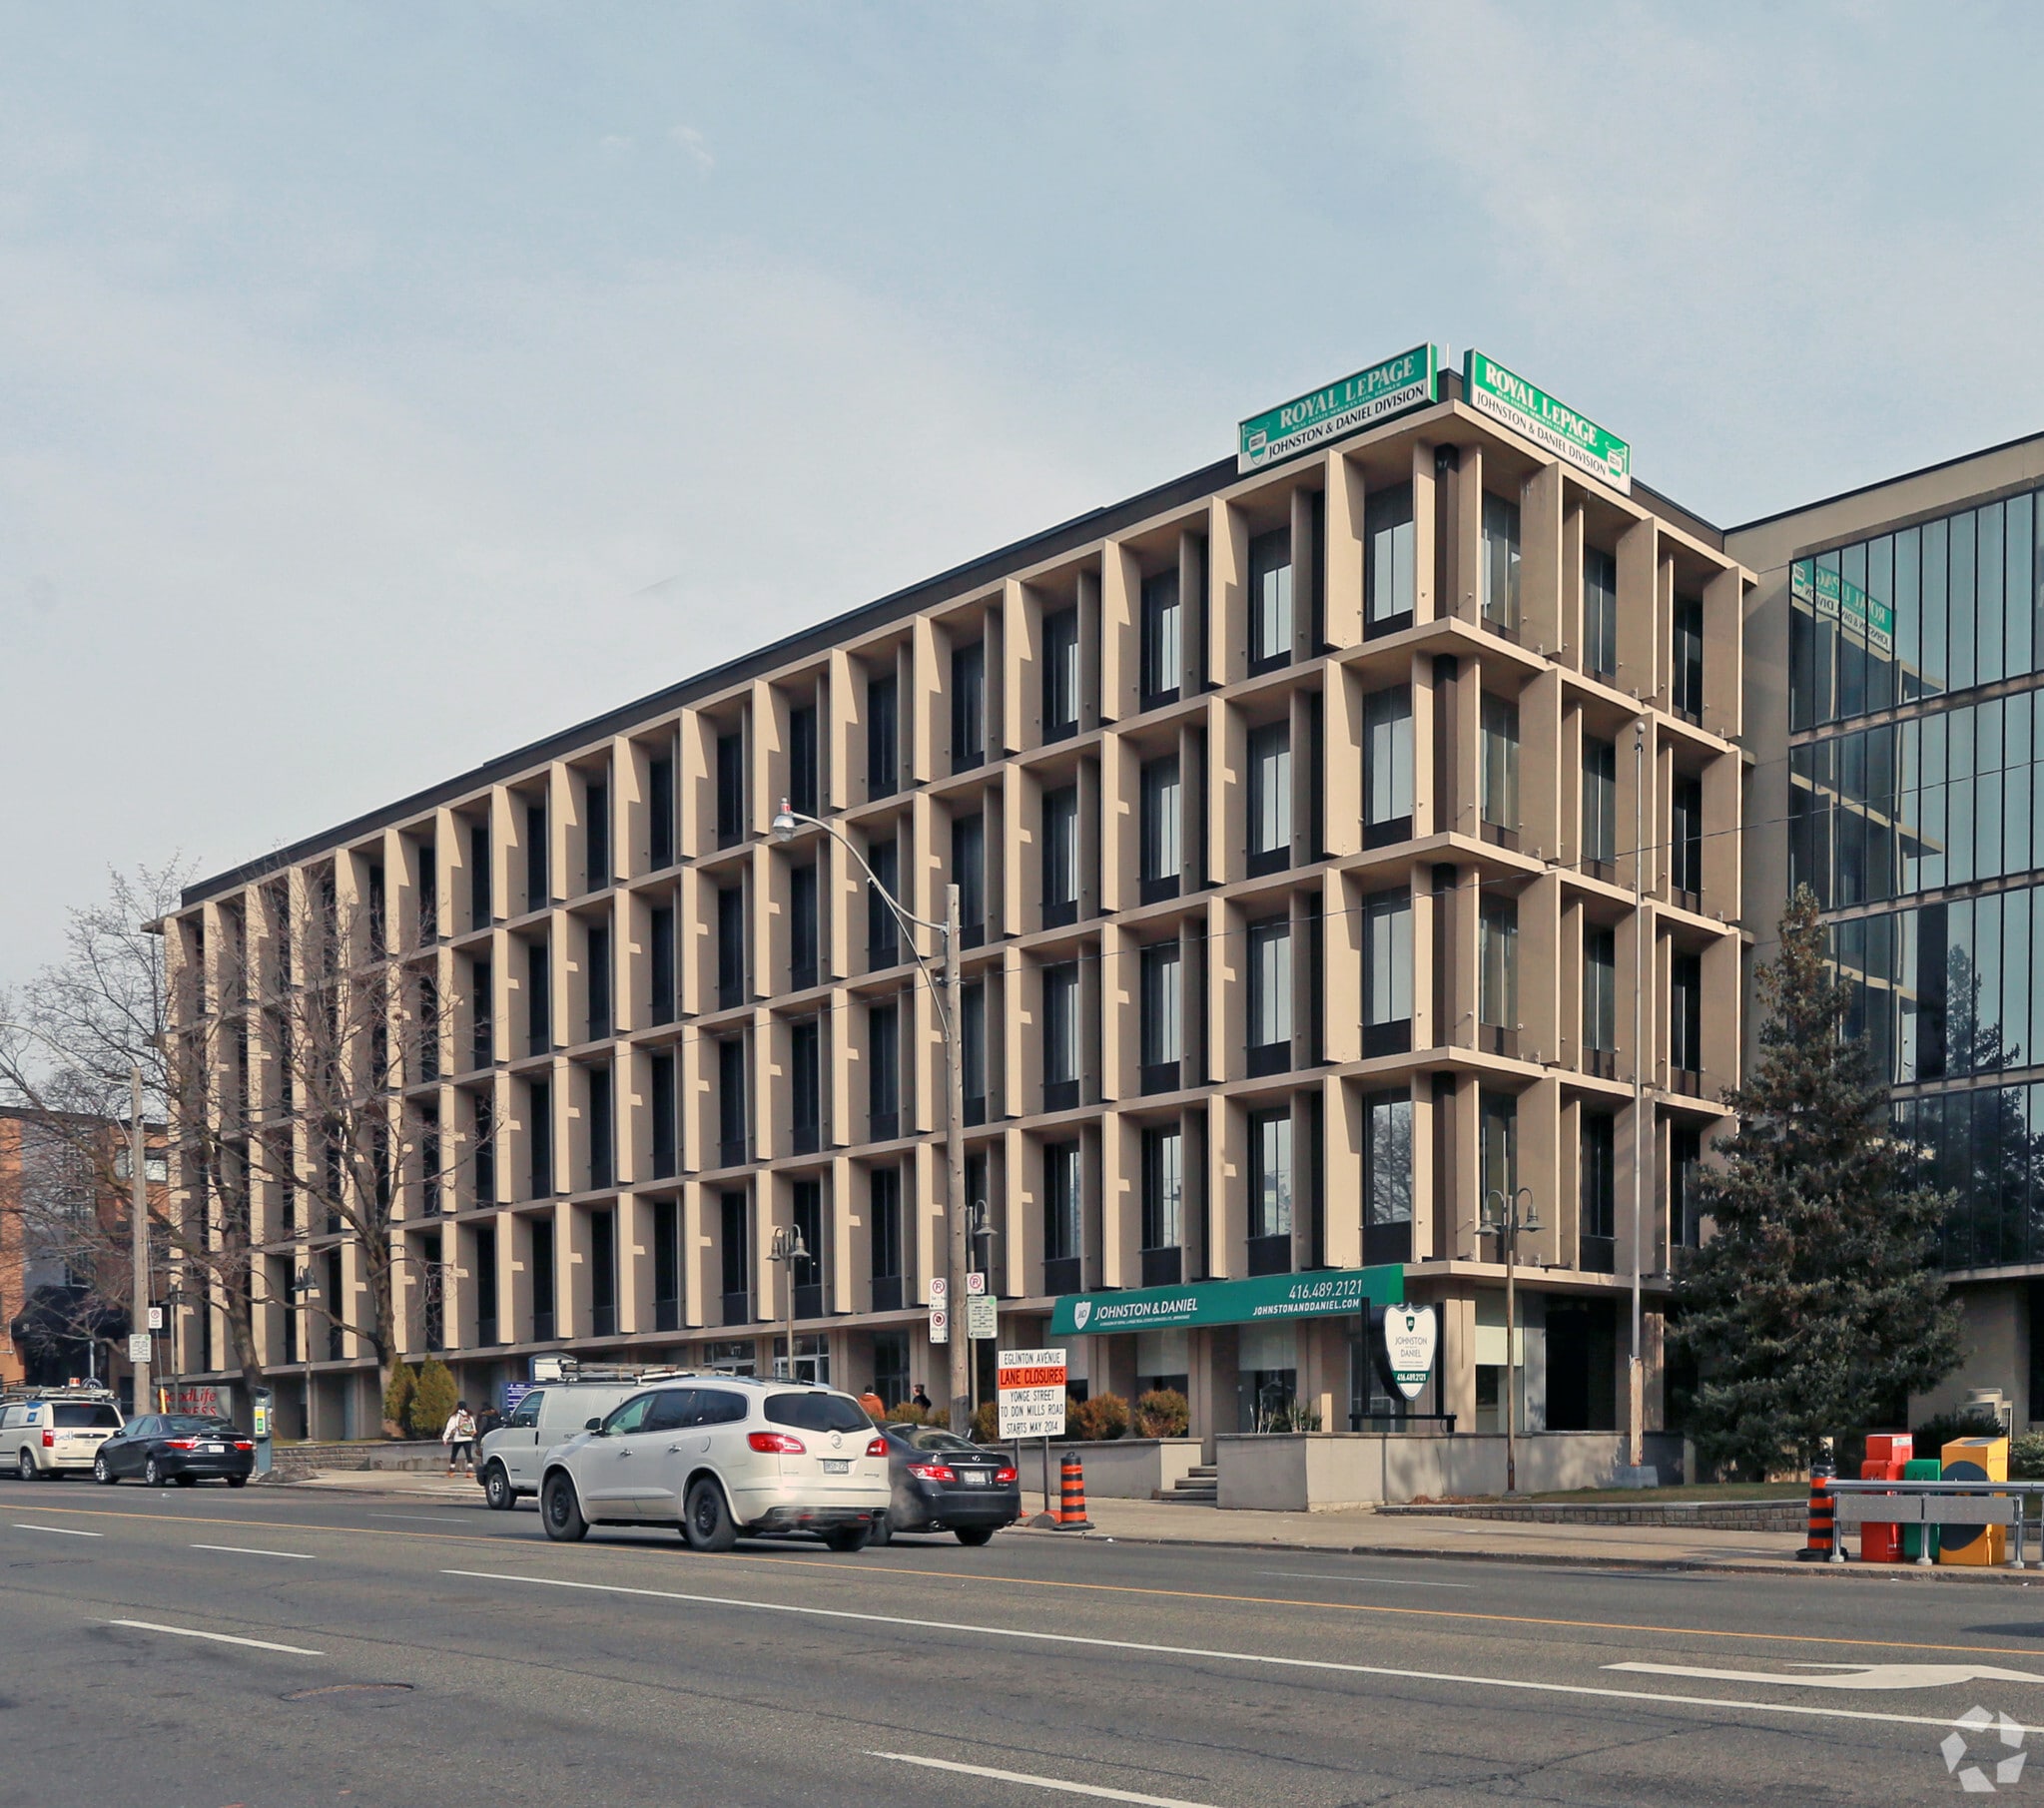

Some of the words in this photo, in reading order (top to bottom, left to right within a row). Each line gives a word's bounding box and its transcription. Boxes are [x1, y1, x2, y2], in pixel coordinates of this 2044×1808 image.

[1486, 361, 1537, 411] ROYAL
[1280, 389, 1339, 429] ROYAL
[1268, 425, 1323, 460] JOHNSTON
[1325, 421, 1334, 434] &
[1336, 407, 1372, 430] DANIEL
[1375, 384, 1425, 414] DIVISION
[1477, 390, 1527, 430] JOHNSTON
[1528, 423, 1536, 434] &
[1537, 426, 1567, 452] DANIEL
[1569, 446, 1607, 476] DIVISION
[1289, 1279, 1362, 1299] 416.489.2121
[1094, 1303, 1150, 1321] JOHNSTON
[1152, 1302, 1159, 1314] &
[1161, 1298, 1198, 1313] DANIEL
[1252, 1298, 1360, 1316] JOHNSTONANDDANIEL.COM
[1395, 1336, 1427, 1346] JOHNSTON
[1005, 1353, 1033, 1365] EGLINTON
[1036, 1352, 1060, 1364] AVENUE
[1001, 1370, 1021, 1385] LANE
[1024, 1369, 1063, 1384] CLOSURES
[1010, 1391, 1029, 1402] YONGE
[1033, 1390, 1054, 1401] STREET
[1001, 1406, 1008, 1418] TO
[1012, 1406, 1023, 1417] DON
[1026, 1405, 1045, 1417] MILLS
[1047, 1404, 1063, 1415] ROAD
[1007, 1423, 1026, 1434] STARTS
[1029, 1422, 1042, 1433] MAY
[1044, 1421, 1057, 1432] 2014
